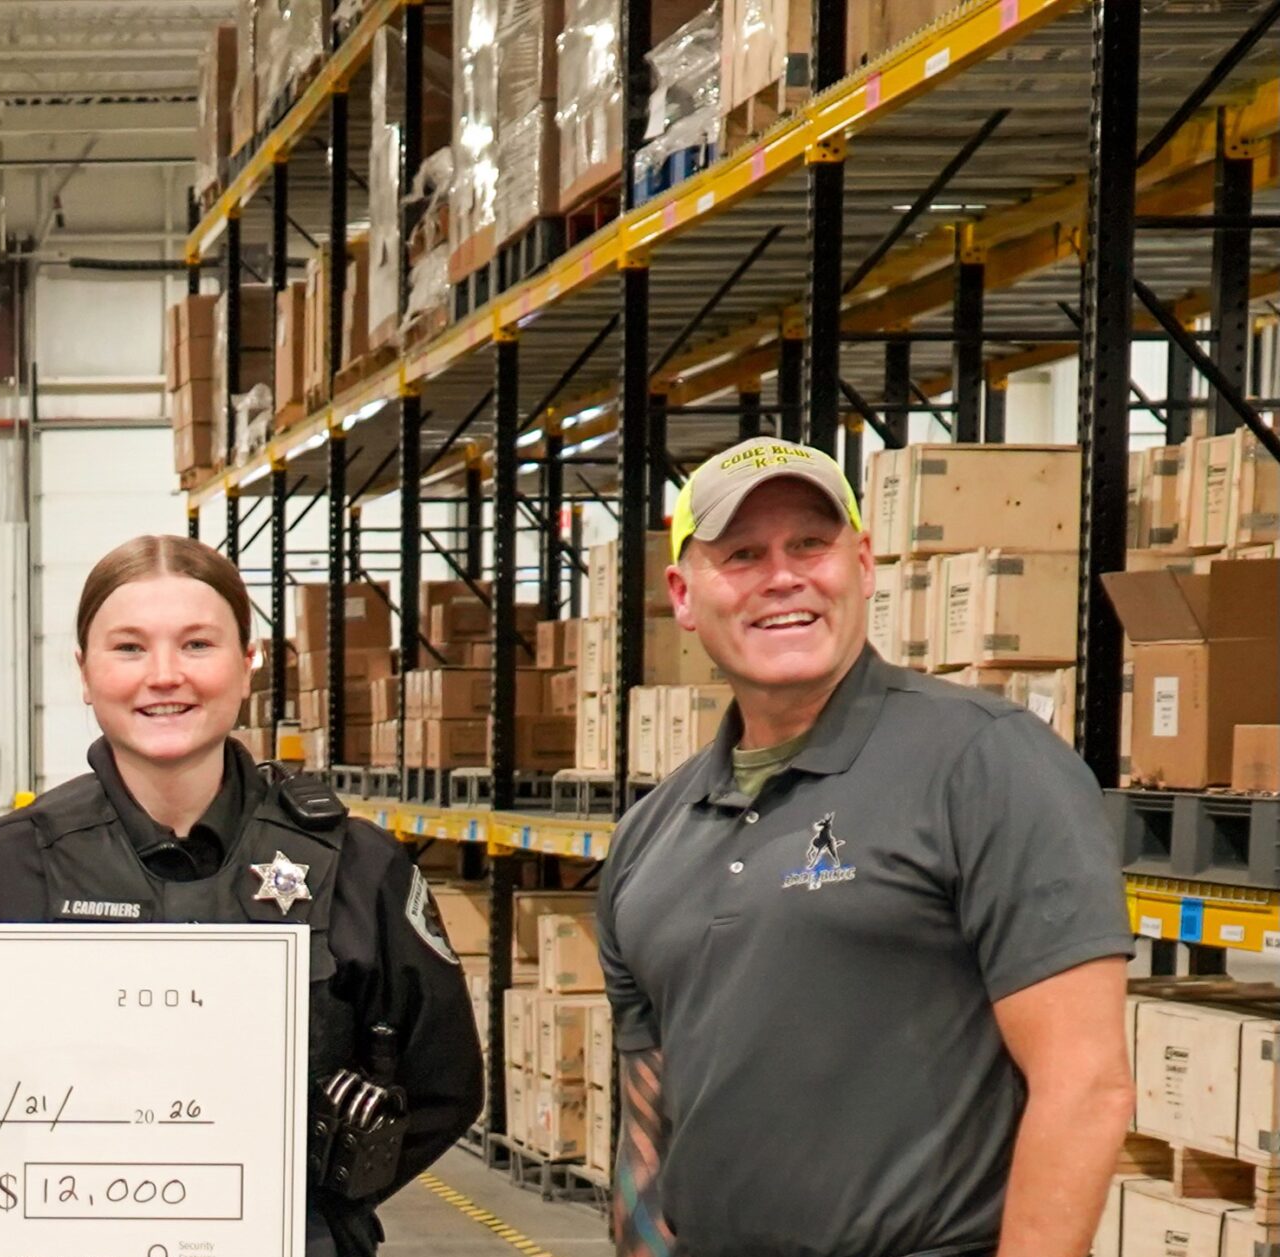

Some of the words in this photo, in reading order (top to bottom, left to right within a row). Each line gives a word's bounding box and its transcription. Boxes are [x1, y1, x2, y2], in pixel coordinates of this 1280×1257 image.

[720, 446, 766, 470] CODE
[61, 900, 71, 914] J.
[72, 900, 141, 919] CAROTHERS
[118, 989, 203, 1007] 2004
[134, 1108, 154, 1125] 20
[169, 1099, 201, 1119] 26
[178, 1240, 215, 1252] Security
